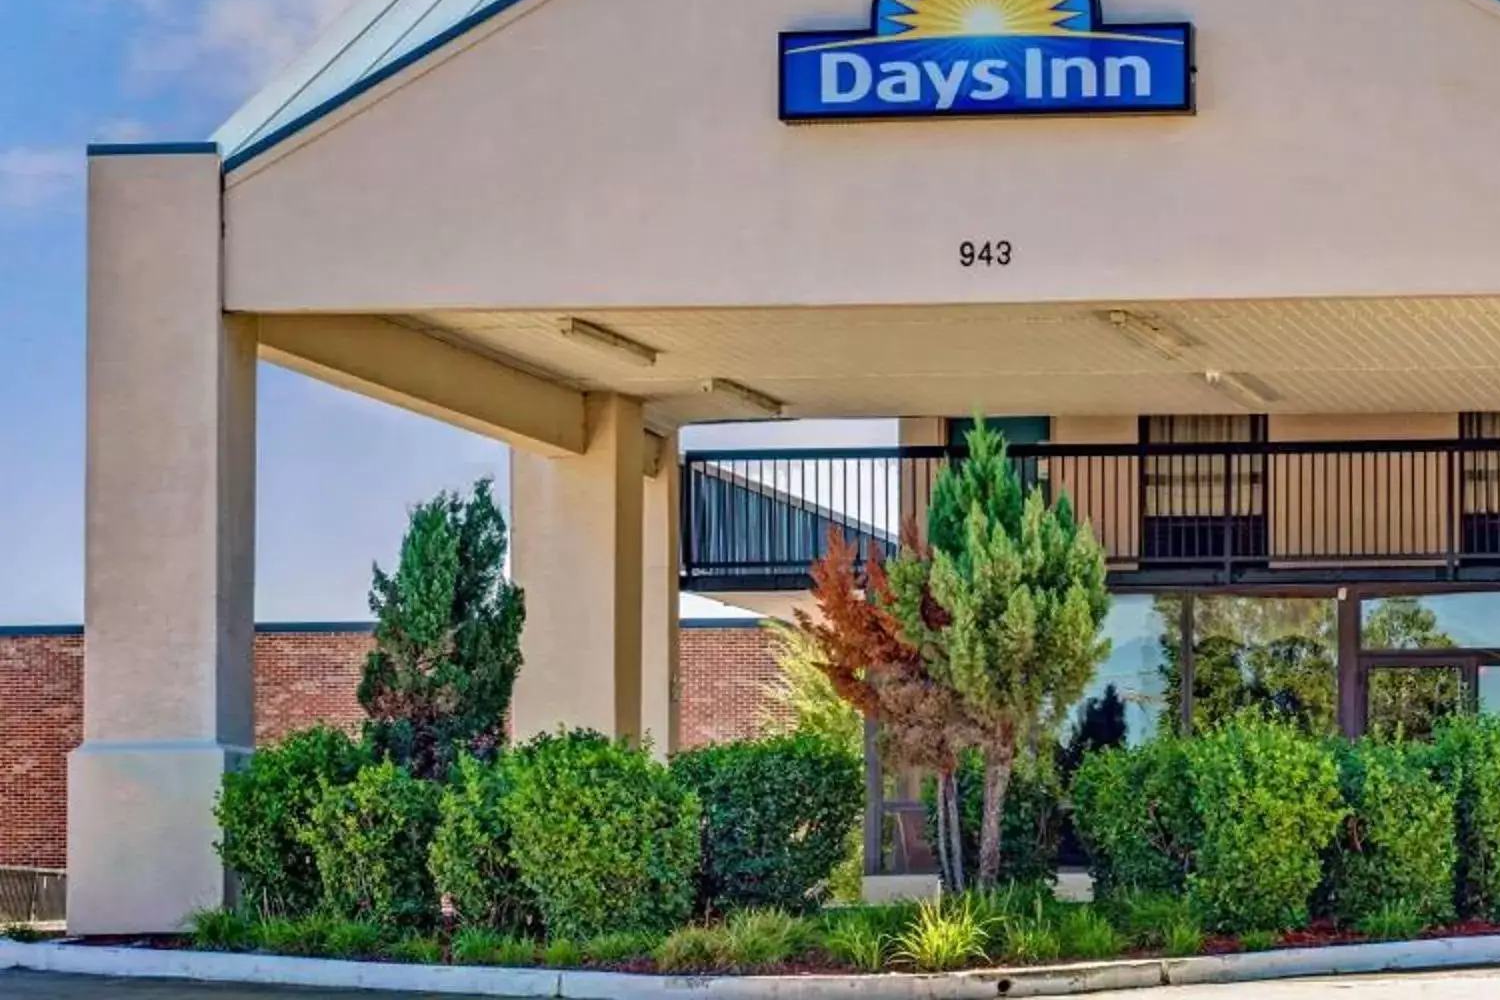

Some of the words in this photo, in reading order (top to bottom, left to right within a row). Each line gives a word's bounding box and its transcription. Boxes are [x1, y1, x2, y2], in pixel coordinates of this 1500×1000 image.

[820, 52, 1009, 110] Days
[1025, 48, 1151, 100] Inn
[959, 241, 1013, 267] 943
